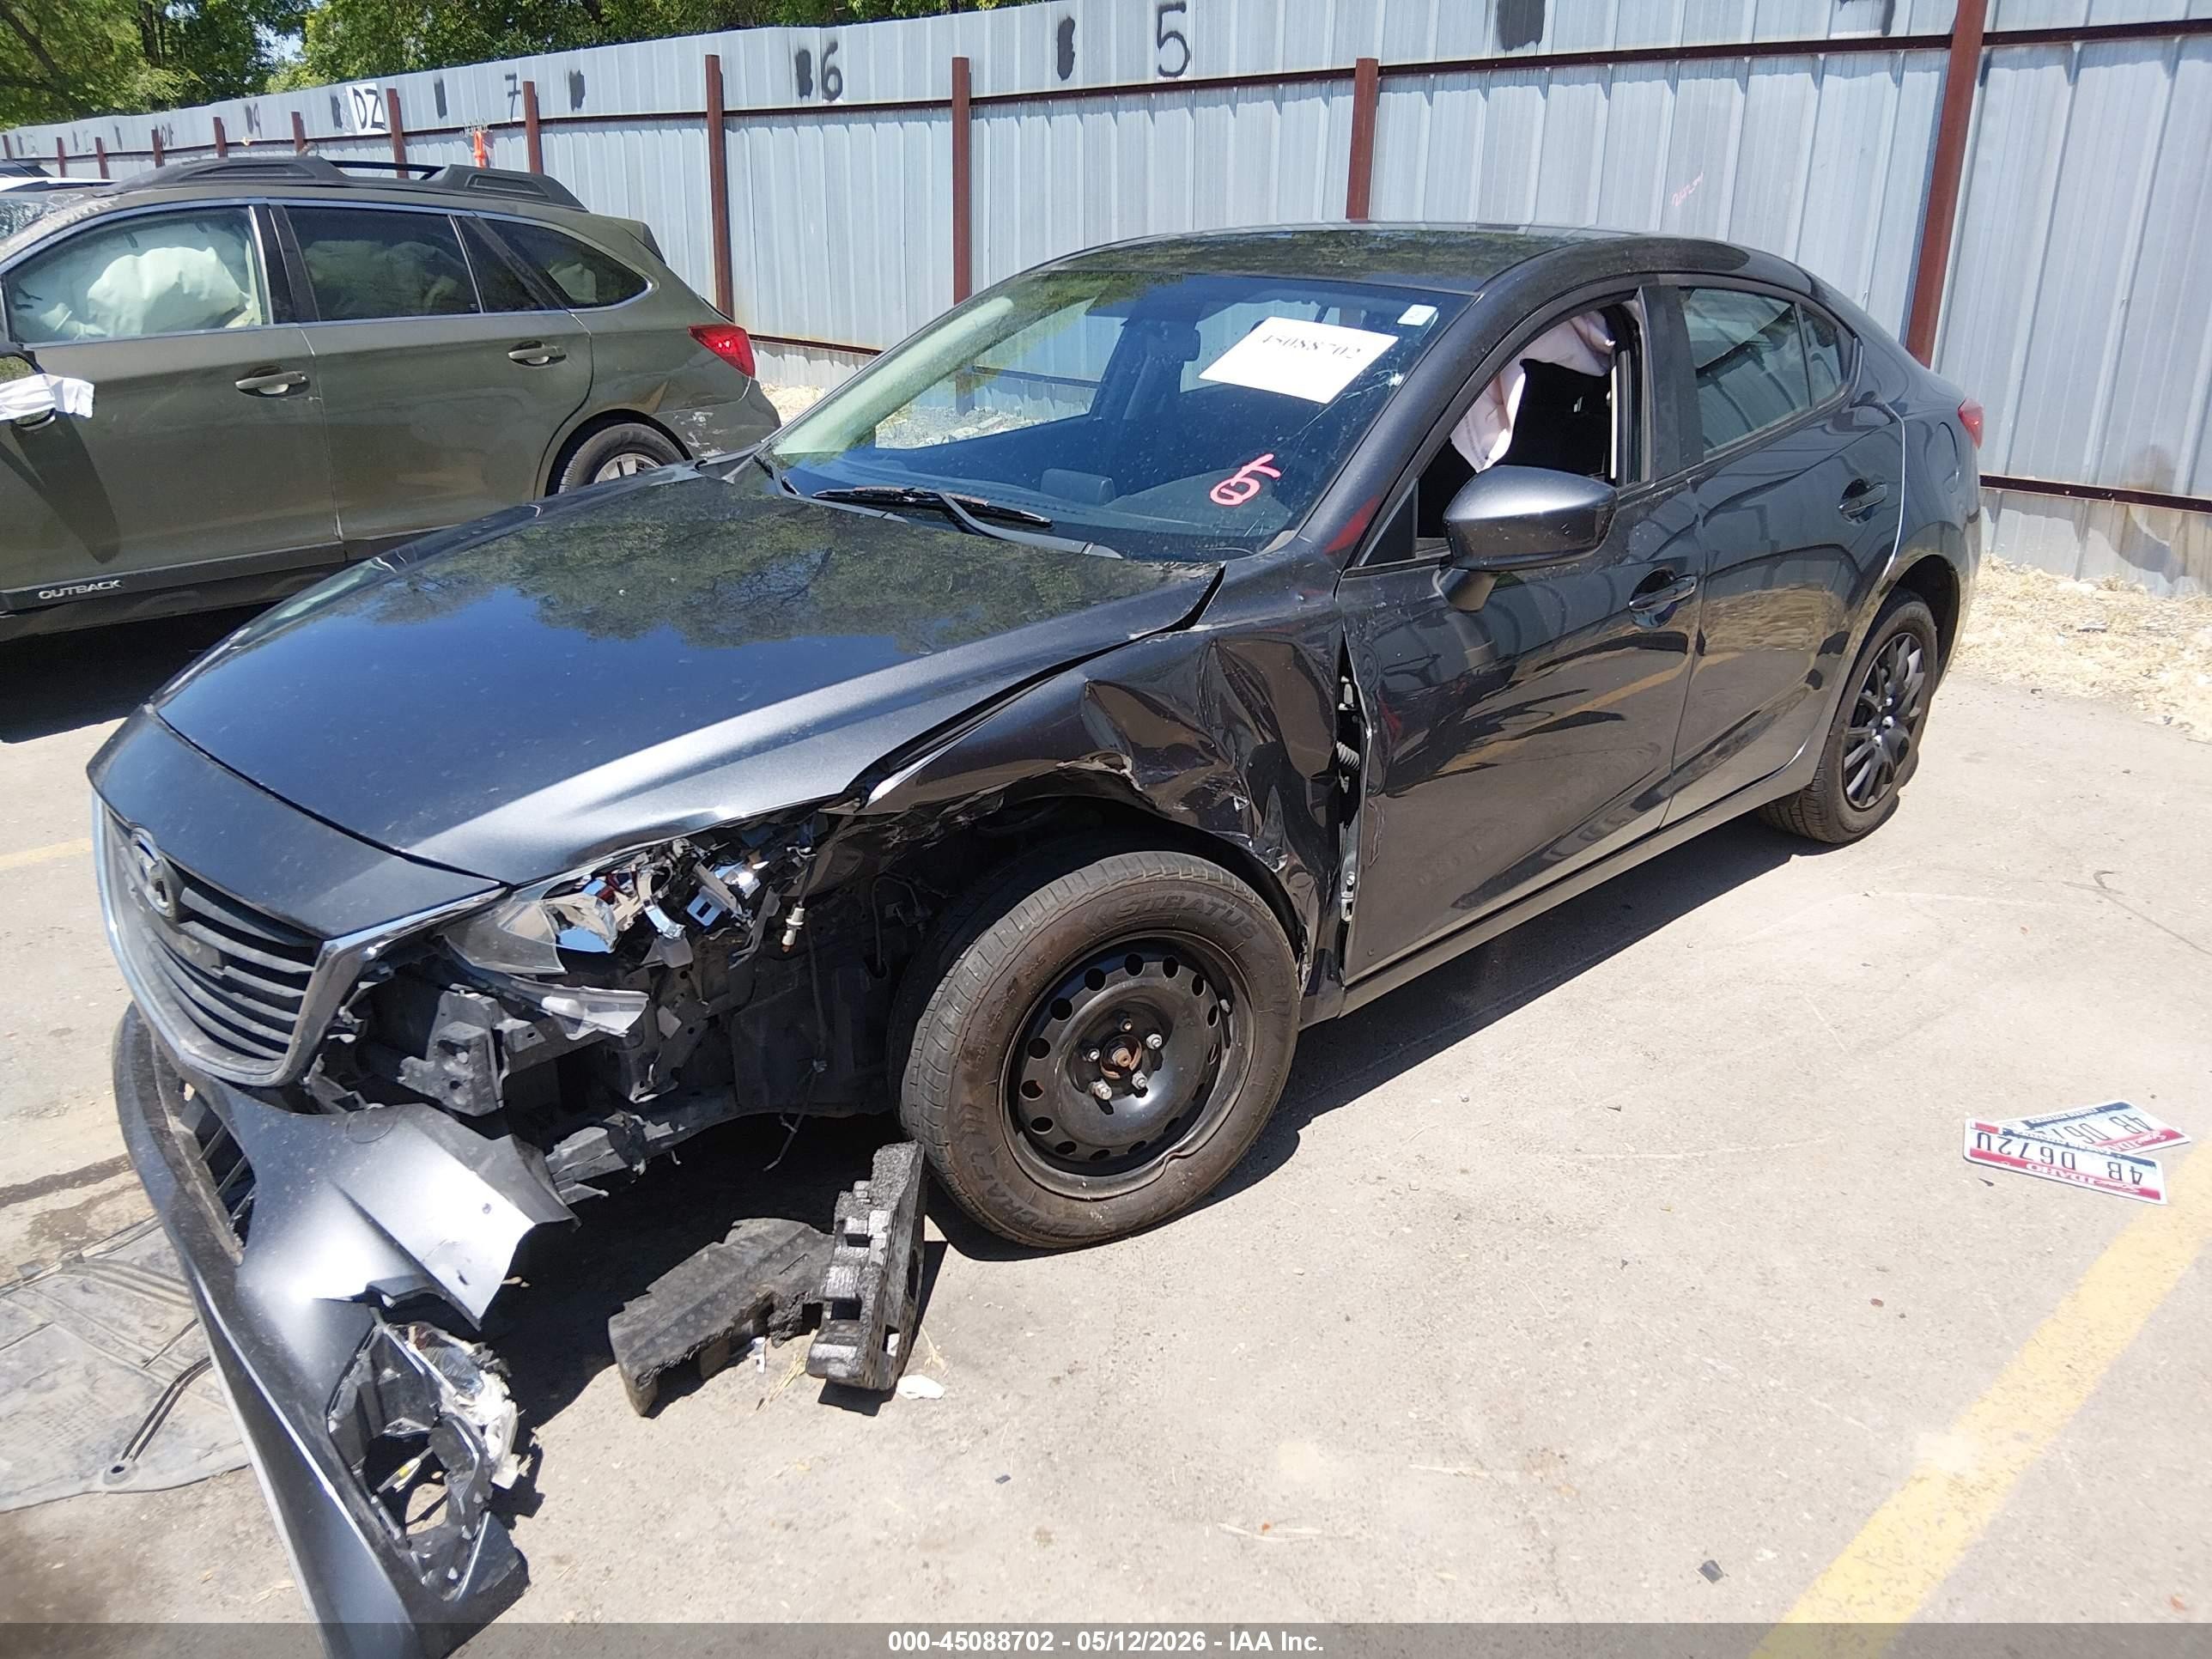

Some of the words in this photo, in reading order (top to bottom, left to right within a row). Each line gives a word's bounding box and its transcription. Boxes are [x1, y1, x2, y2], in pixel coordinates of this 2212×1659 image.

[1157, 3, 1190, 78] 5
[505, 72, 521, 123] 7
[39, 580, 123, 599] OUTBACK
[1116, 892, 1260, 943] STRATUS
[1977, 1132, 2076, 1170] D672U
[2027, 1163, 2095, 1185] IDAHO
[2107, 1162, 2142, 1185] 4B
